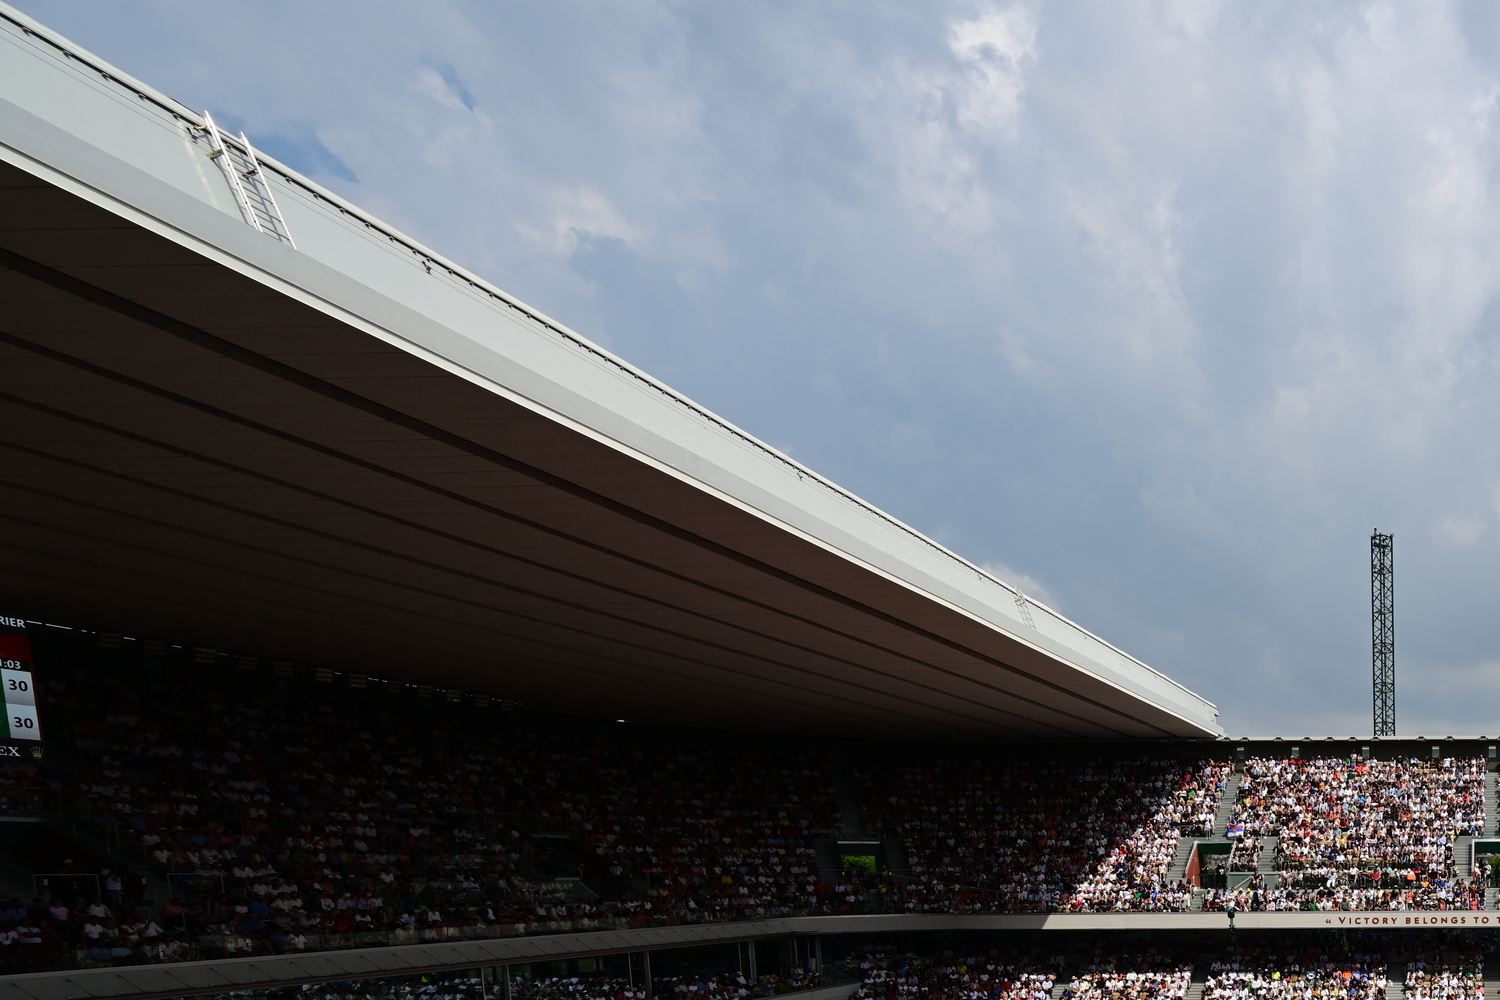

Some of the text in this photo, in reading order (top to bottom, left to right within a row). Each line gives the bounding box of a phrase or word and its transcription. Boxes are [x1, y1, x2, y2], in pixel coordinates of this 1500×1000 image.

[8, 679, 28, 692] 30
[14, 717, 34, 729] 30
[1338, 916, 1398, 925] VICTORY
[1405, 916, 1466, 925] BELONGS
[1473, 916, 1490, 924] TO
